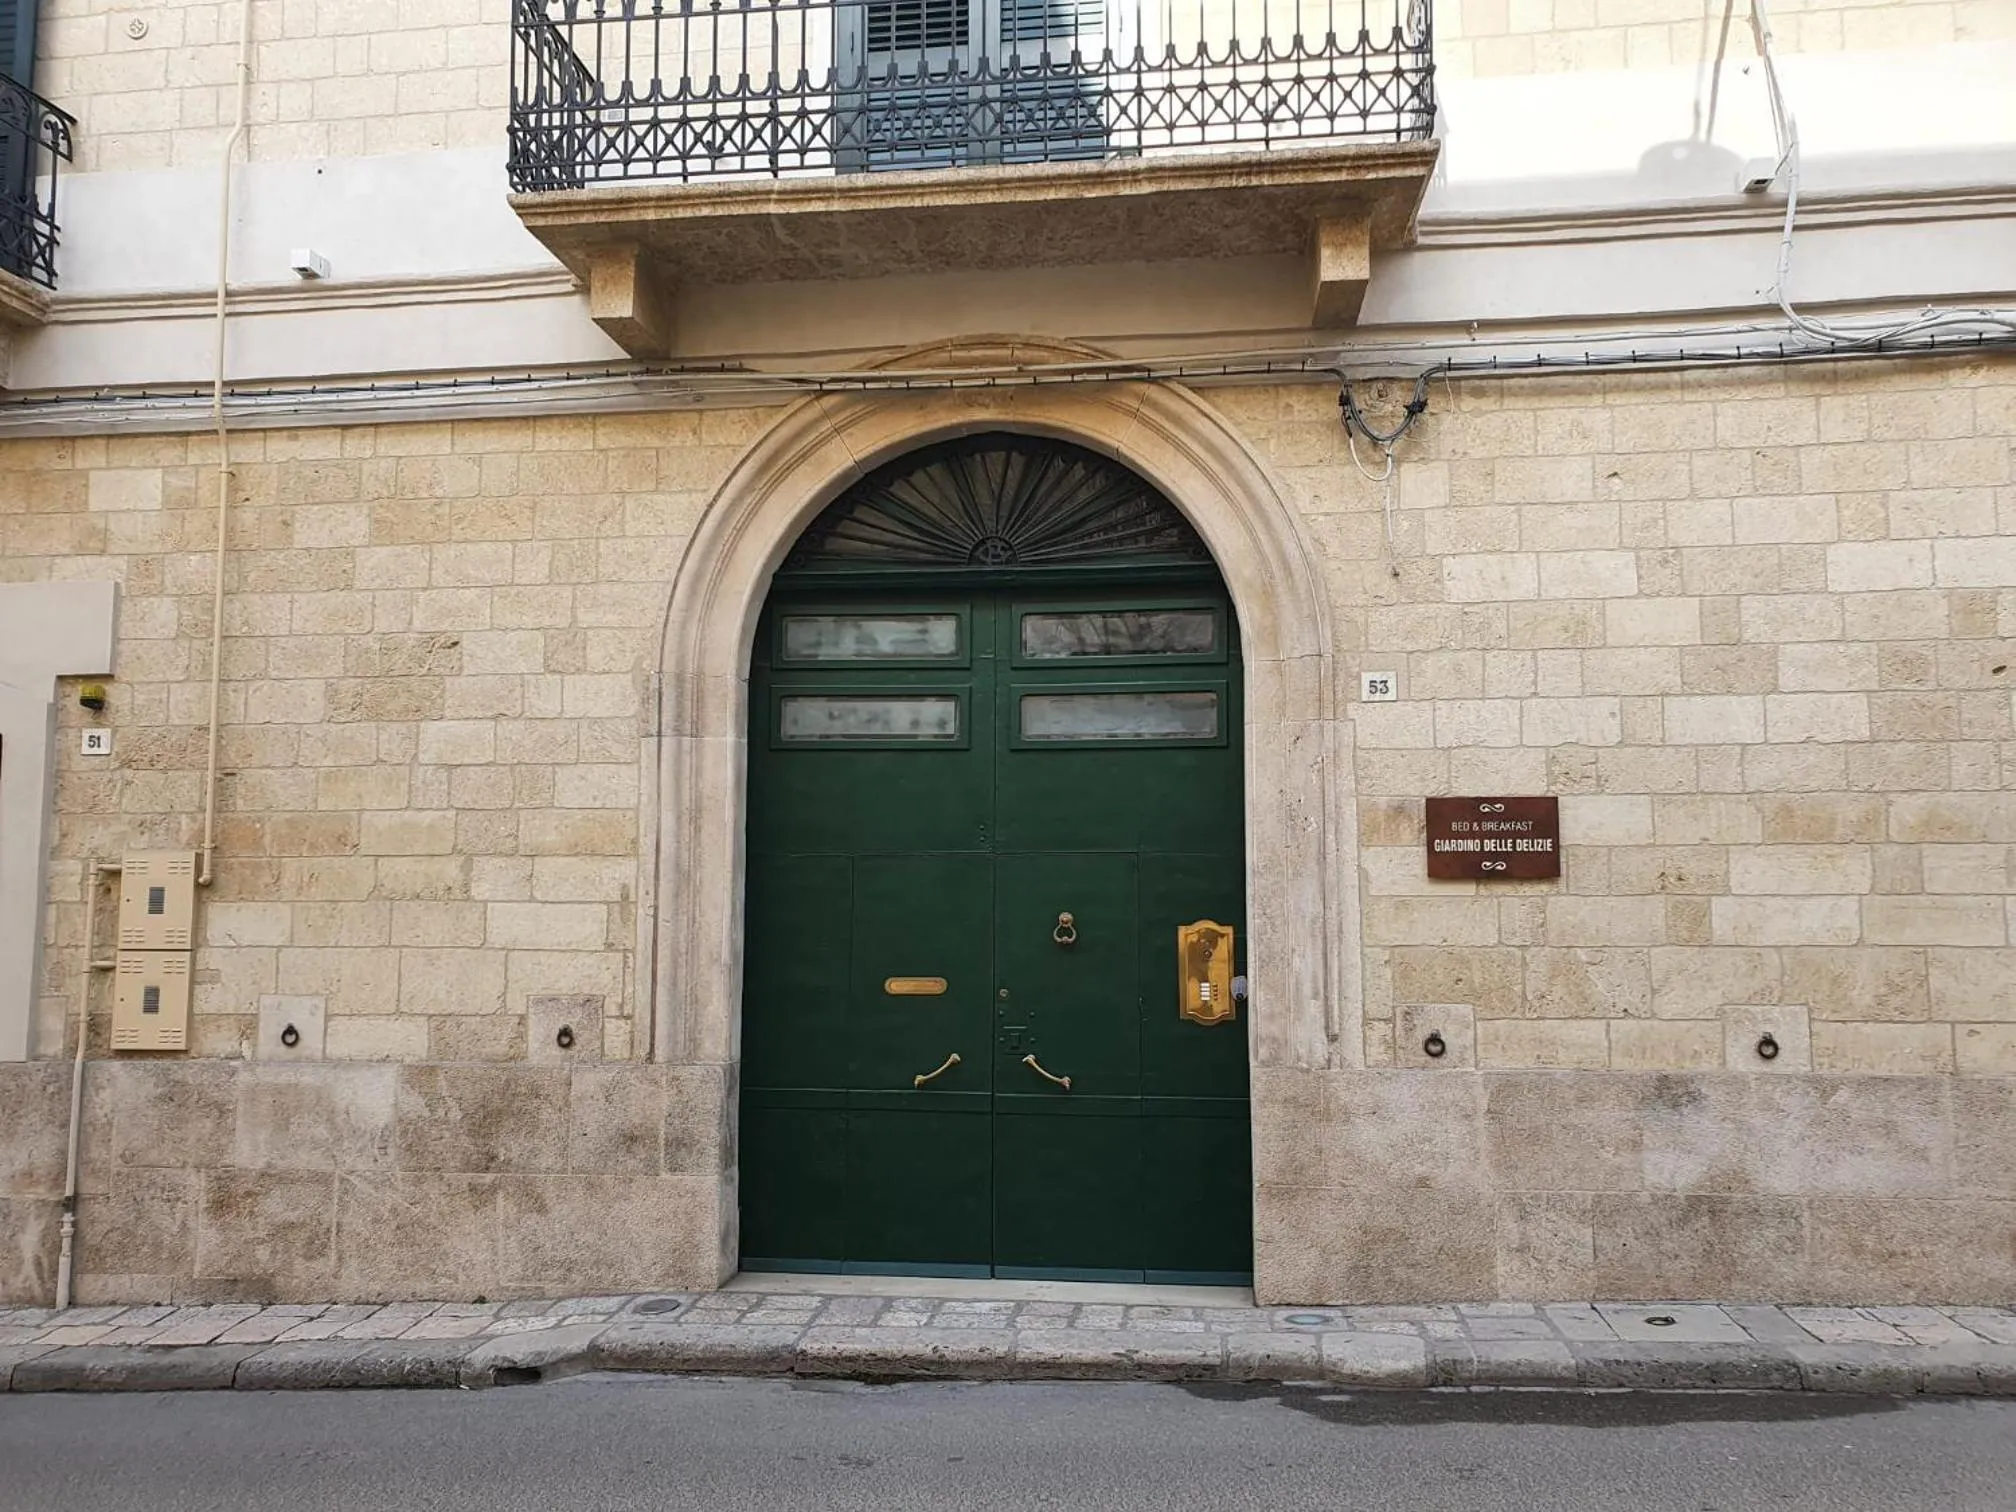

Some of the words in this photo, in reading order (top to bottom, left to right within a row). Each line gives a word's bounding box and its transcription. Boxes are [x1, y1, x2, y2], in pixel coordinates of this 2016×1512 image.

[1369, 680, 1389, 694] 53
[88, 735, 101, 748] 51
[1451, 821, 1470, 832] BED
[1472, 821, 1479, 831] &
[1482, 821, 1534, 831] BREAKFAST
[1434, 839, 1481, 852] GIARDINO
[1484, 839, 1513, 852] DELLE
[1516, 839, 1553, 852] DELIZIE
